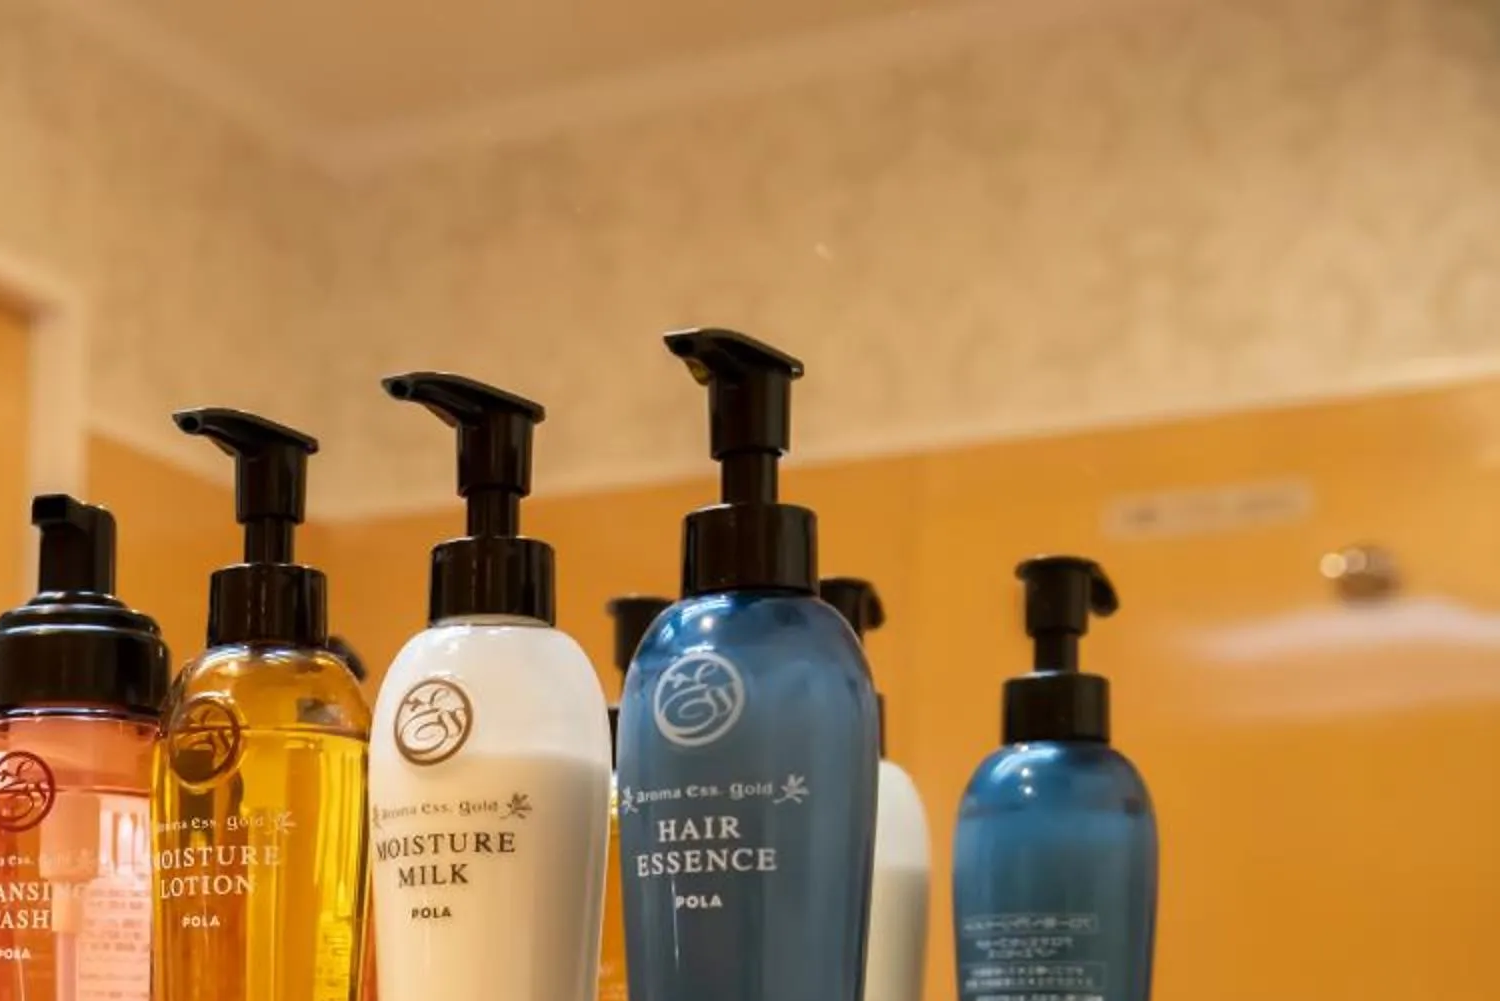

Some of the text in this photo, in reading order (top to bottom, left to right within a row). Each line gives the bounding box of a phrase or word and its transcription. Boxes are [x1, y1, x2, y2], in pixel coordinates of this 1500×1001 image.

[657, 815, 741, 843] HAIR
[376, 831, 516, 862] MOISTURE
[637, 848, 778, 877] ESSENCE
[160, 874, 256, 899] LOTION
[398, 863, 469, 888] MILK
[411, 906, 452, 919] POLA
[675, 893, 724, 909] POLA
[182, 914, 221, 928] POLA
